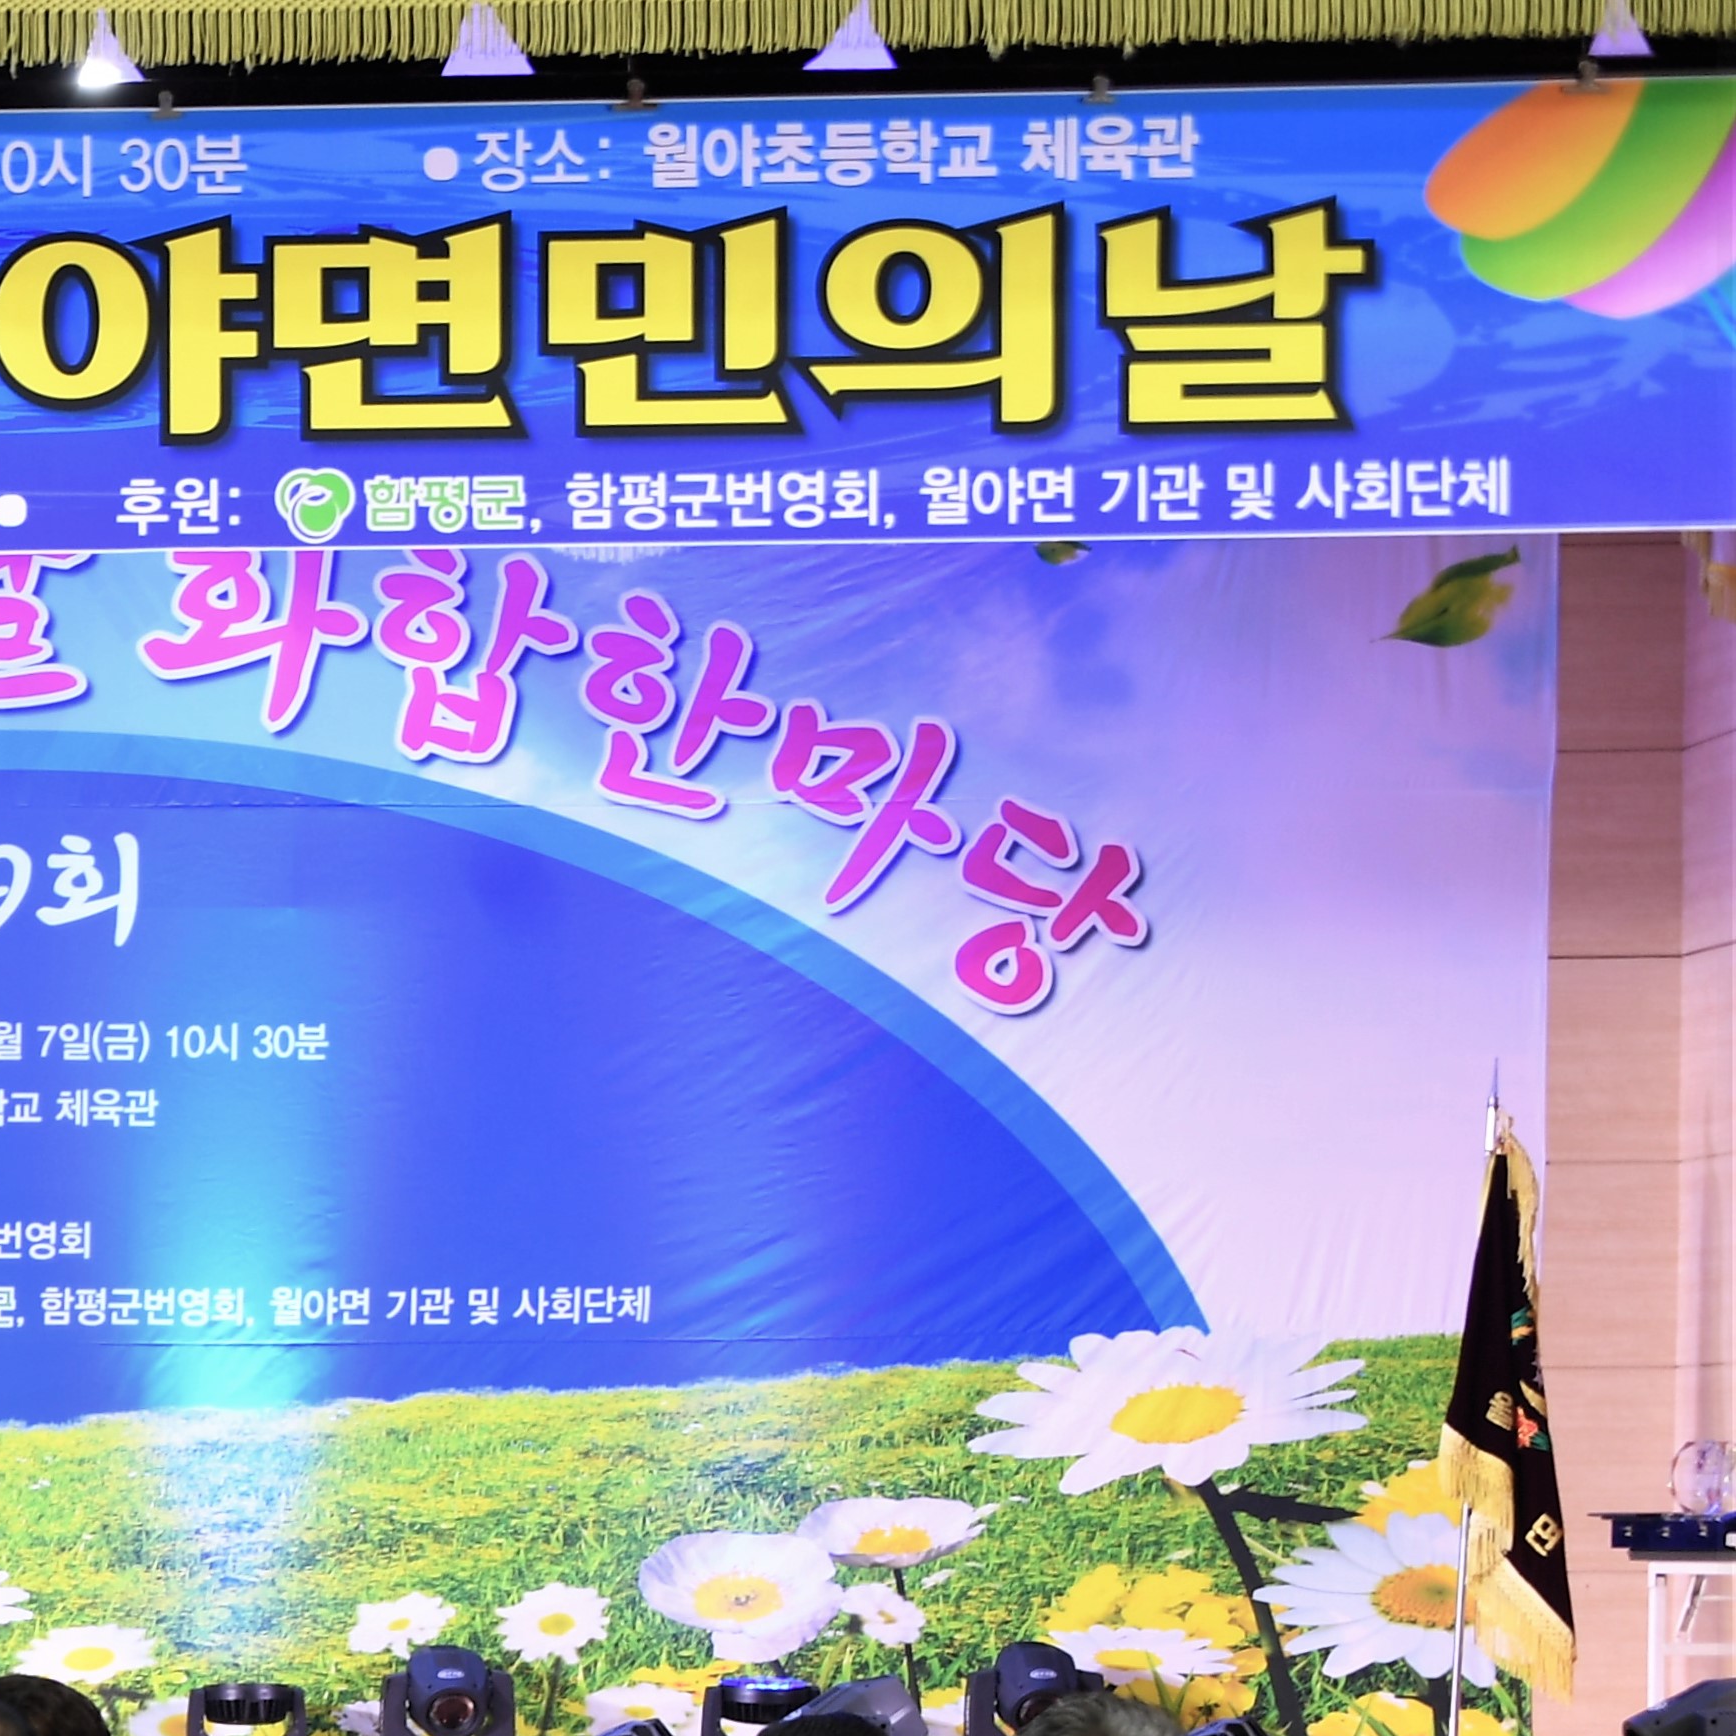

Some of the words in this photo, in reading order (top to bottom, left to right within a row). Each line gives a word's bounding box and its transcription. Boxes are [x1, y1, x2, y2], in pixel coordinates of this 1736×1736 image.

[119, 135, 248, 195] 30분
[474, 128, 610, 193] 장소:
[644, 120, 998, 189] 월야초등학교
[1020, 115, 1200, 181] 체육관
[115, 476, 242, 537] 후원:
[564, 464, 897, 531] 함평군번영회,
[918, 465, 1075, 526] 월야면
[1099, 462, 1206, 523] 기관
[1226, 461, 1275, 520] 및
[1295, 456, 1512, 519] 사회단체
[37, 1020, 151, 1063] 7일(금)
[166, 1022, 239, 1062] 10시
[252, 1023, 330, 1061] 30분
[55, 1088, 160, 1128] 체육관
[40, 1285, 256, 1328] 함평군번영회,
[269, 1285, 371, 1327] 월야면
[386, 1287, 455, 1326] 기관
[468, 1286, 499, 1325] 및
[513, 1285, 652, 1325] 사회단체
